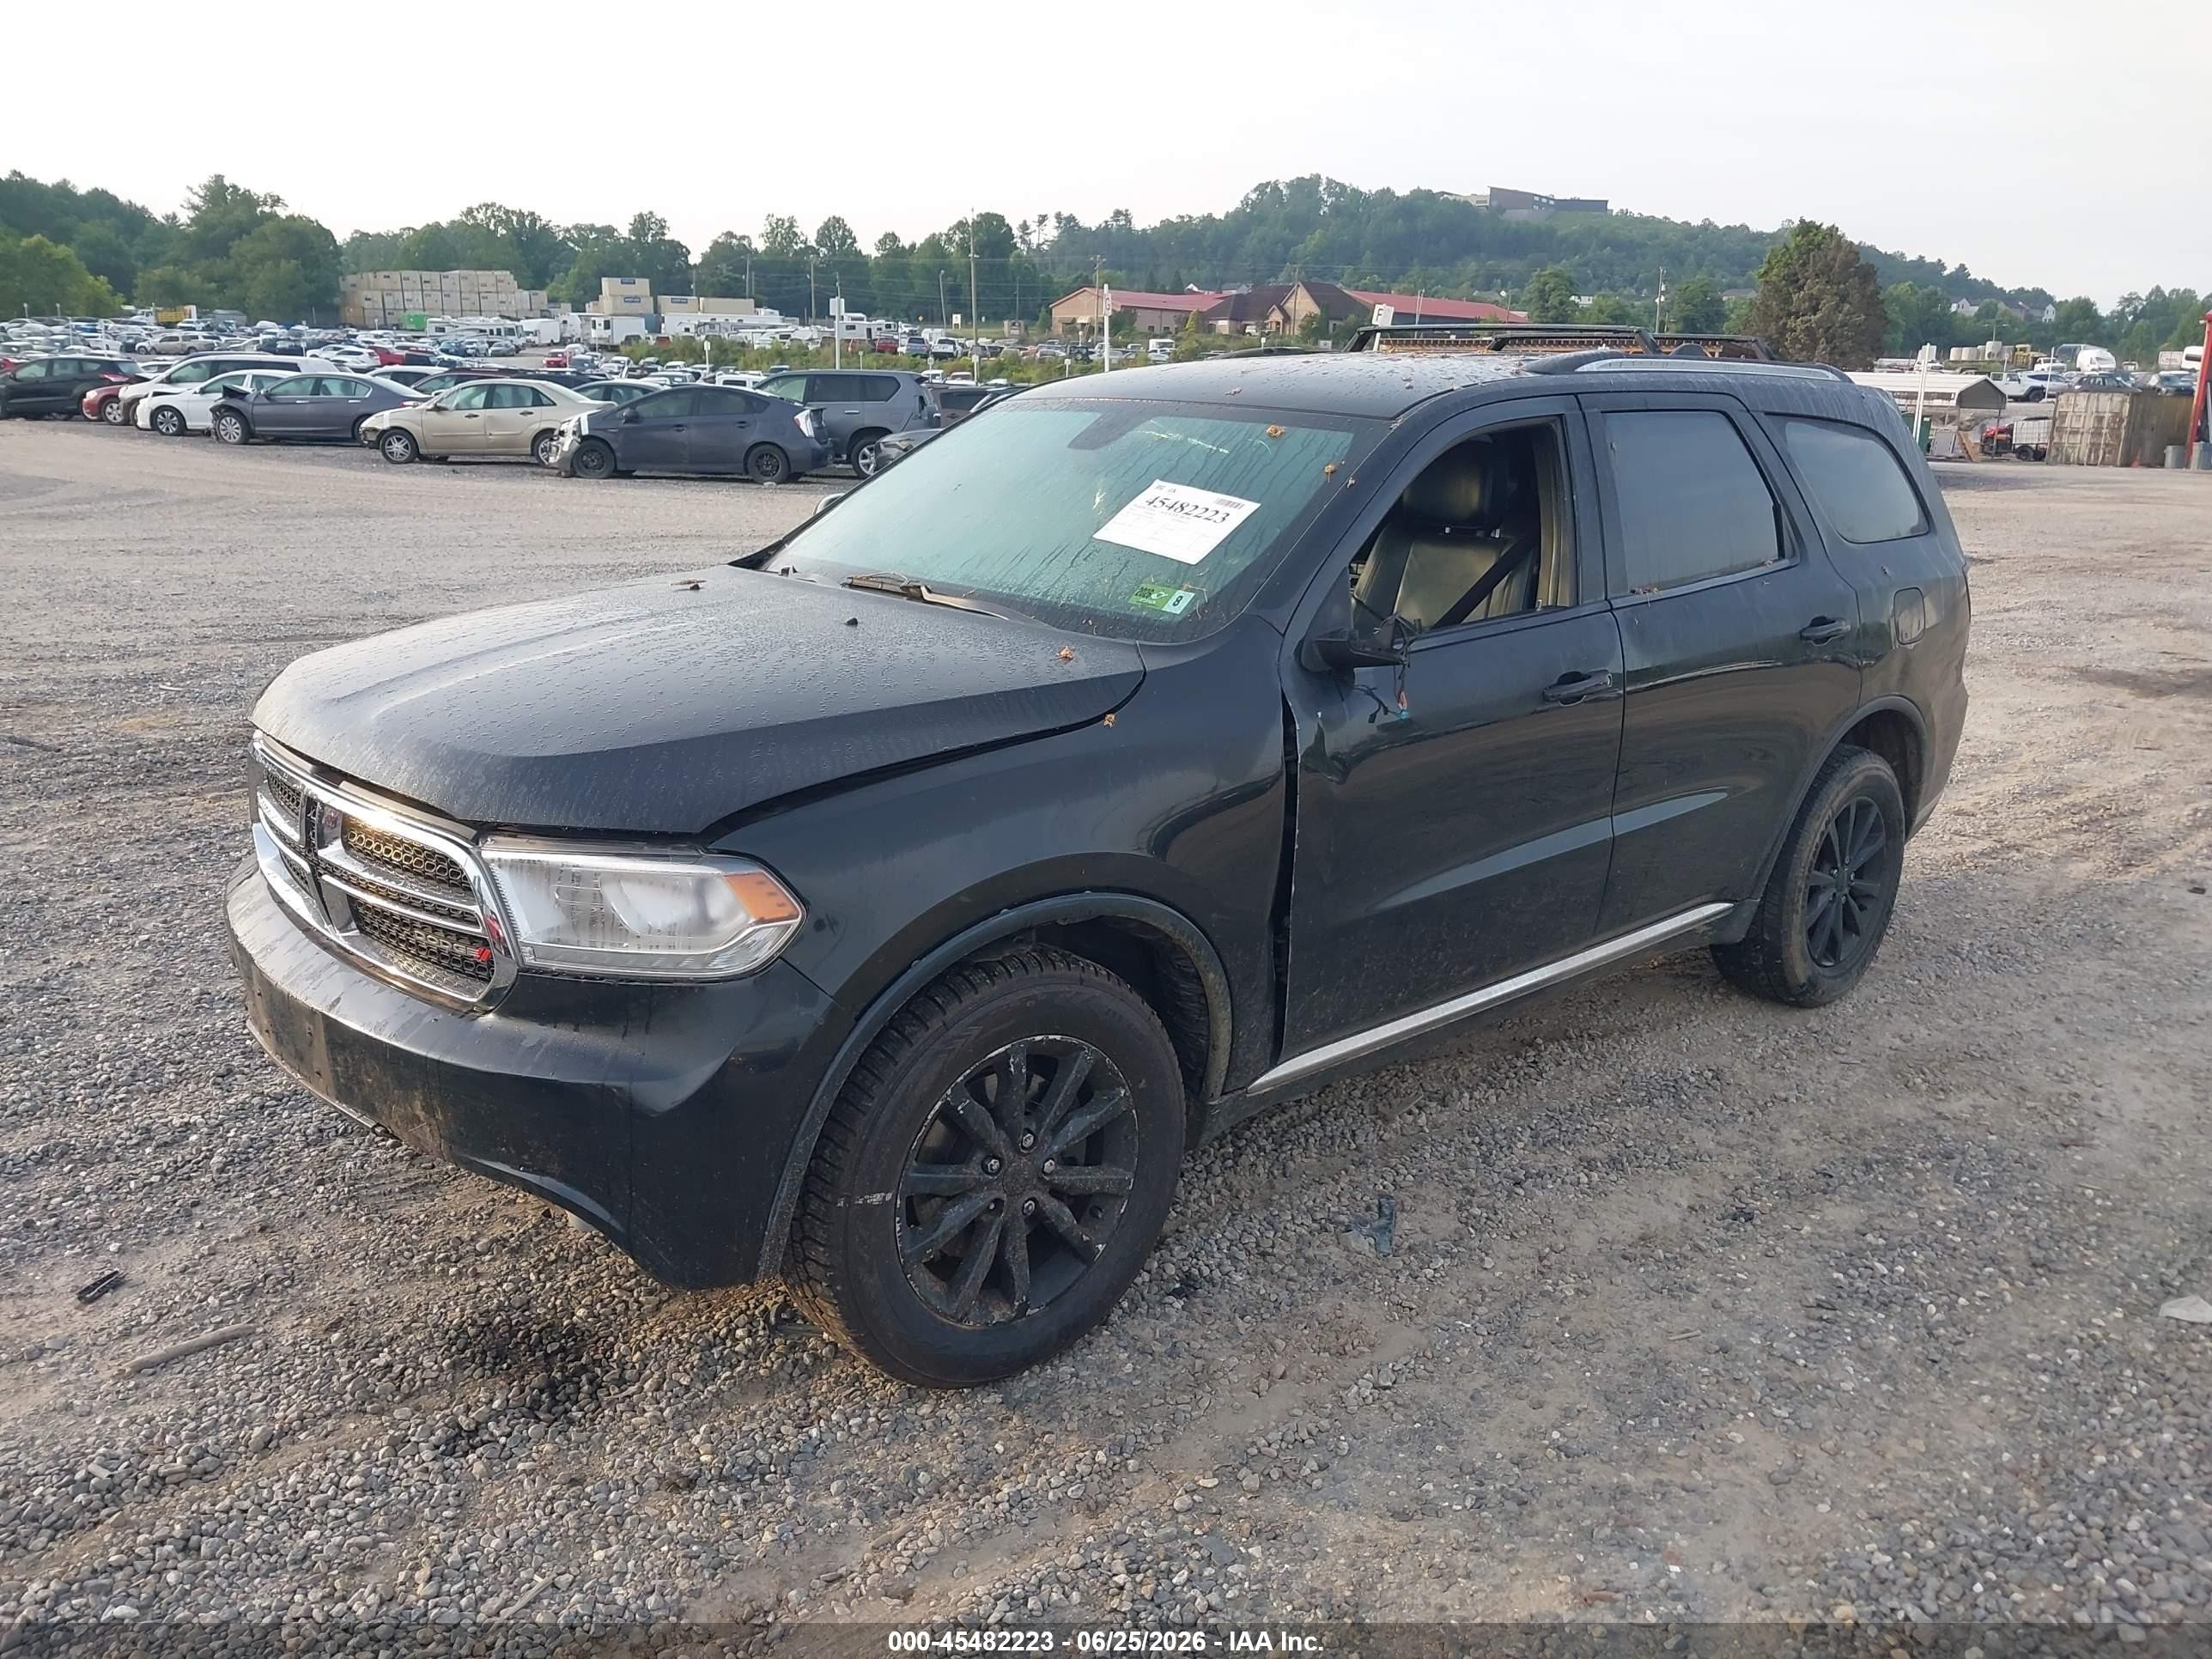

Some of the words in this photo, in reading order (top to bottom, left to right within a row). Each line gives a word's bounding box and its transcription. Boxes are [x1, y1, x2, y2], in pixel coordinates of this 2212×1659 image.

[1376, 307, 1383, 322] F
[1146, 495, 1231, 524] 45482223
[1172, 595, 1183, 607] 8
[413, 930, 479, 958] DODGE
